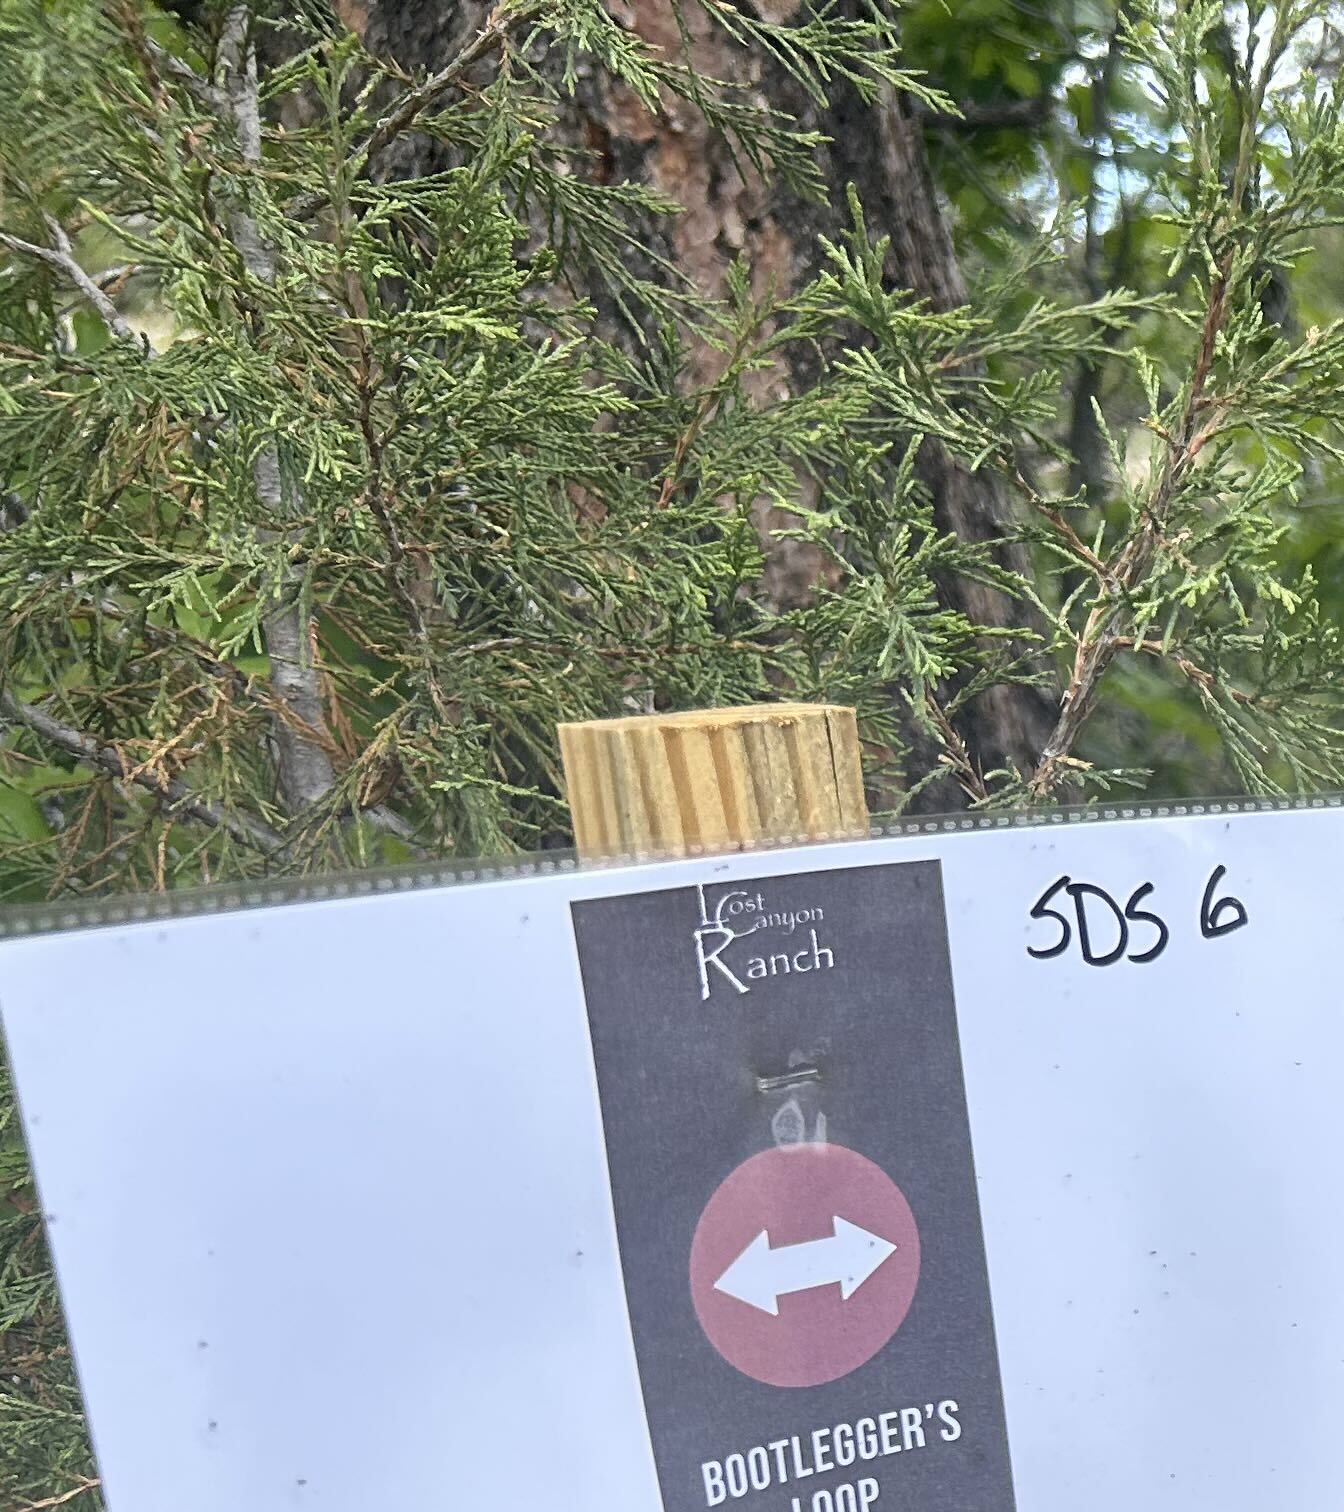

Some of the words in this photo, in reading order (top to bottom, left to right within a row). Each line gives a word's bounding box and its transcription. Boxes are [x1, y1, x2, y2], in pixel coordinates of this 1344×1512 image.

[697, 883, 765, 926] Lost
[716, 891, 824, 938] Canyon
[1026, 875, 1170, 967] SDS
[1200, 864, 1249, 939] 6
[693, 927, 835, 1001] Ranch
[701, 1400, 962, 1507] BOOTLEGGER'S
